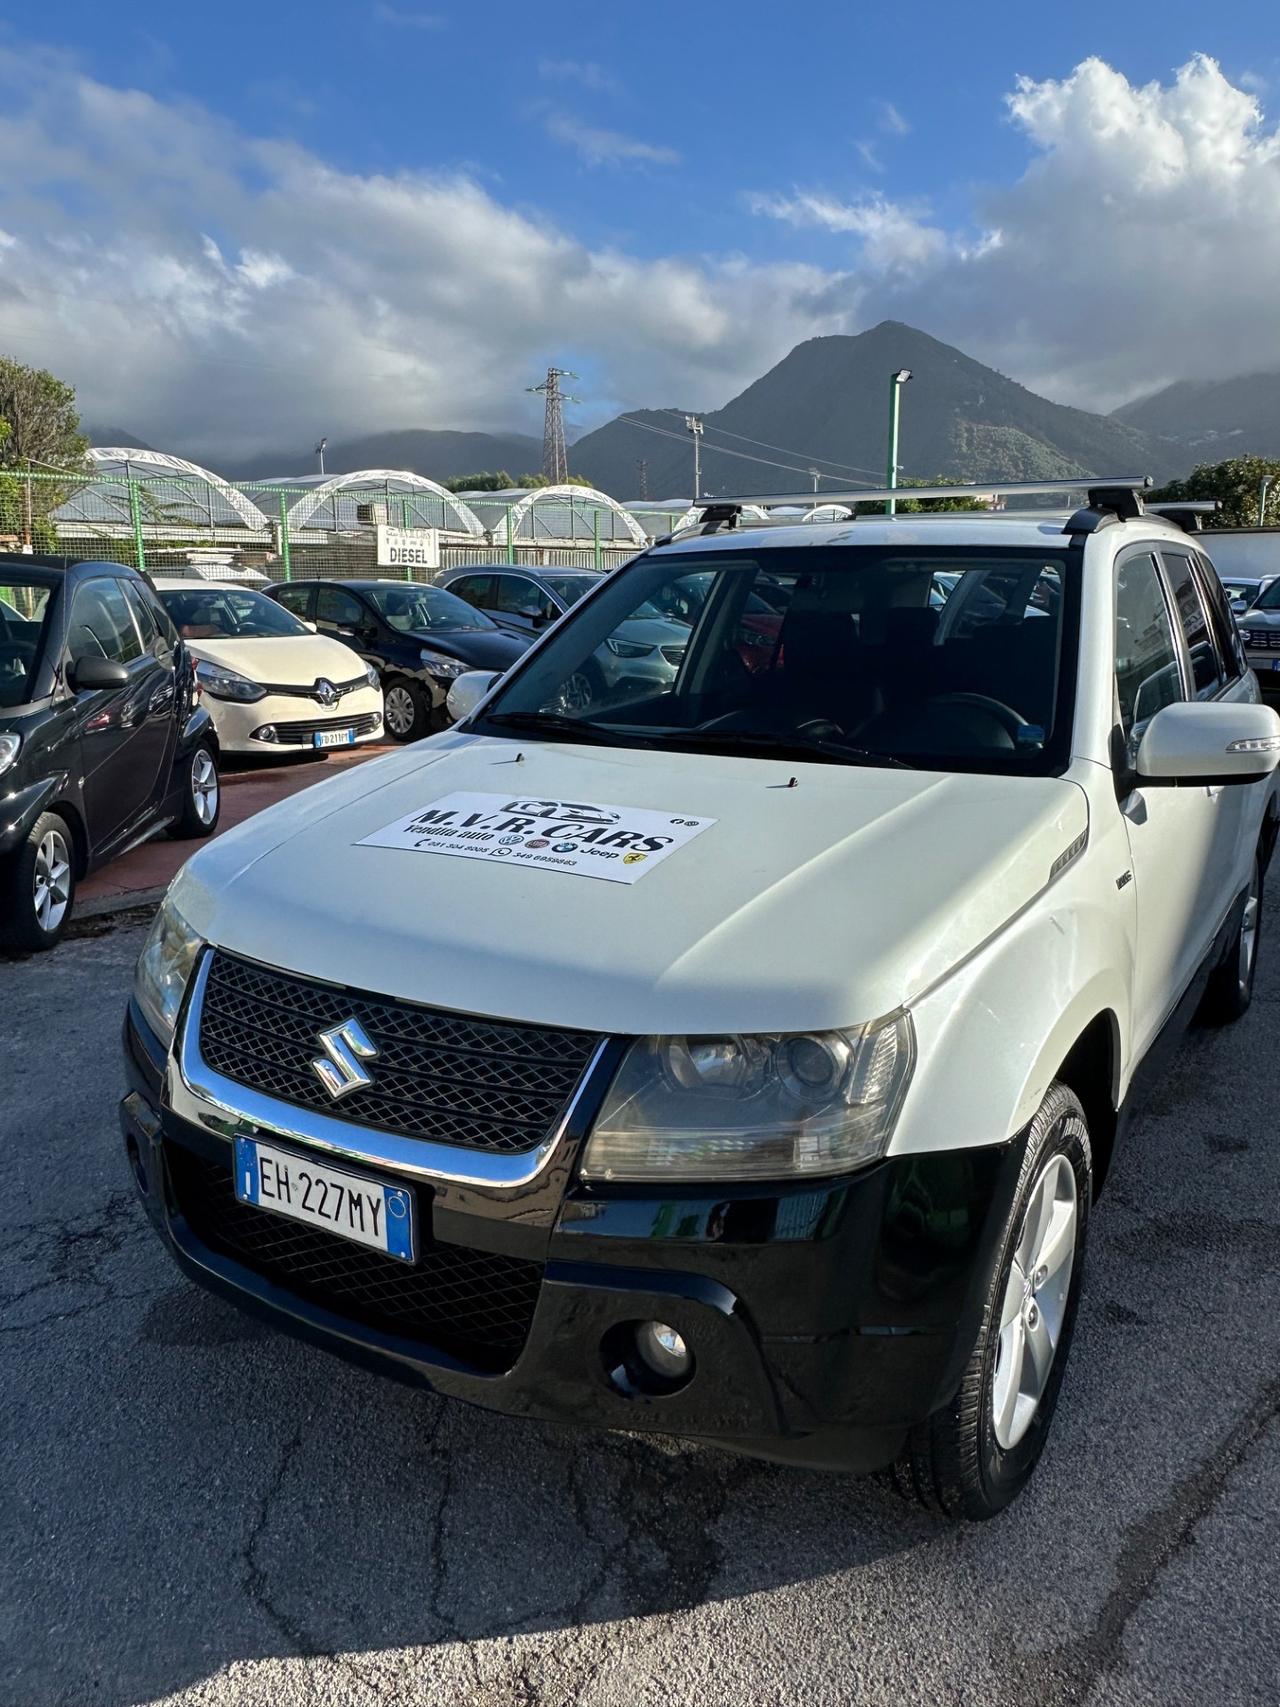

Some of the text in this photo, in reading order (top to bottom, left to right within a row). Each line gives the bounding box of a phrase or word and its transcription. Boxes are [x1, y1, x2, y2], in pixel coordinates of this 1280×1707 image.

[390, 547, 428, 564] DIESEL
[403, 824, 495, 841] Vendita auto
[580, 847, 620, 859] Jeep
